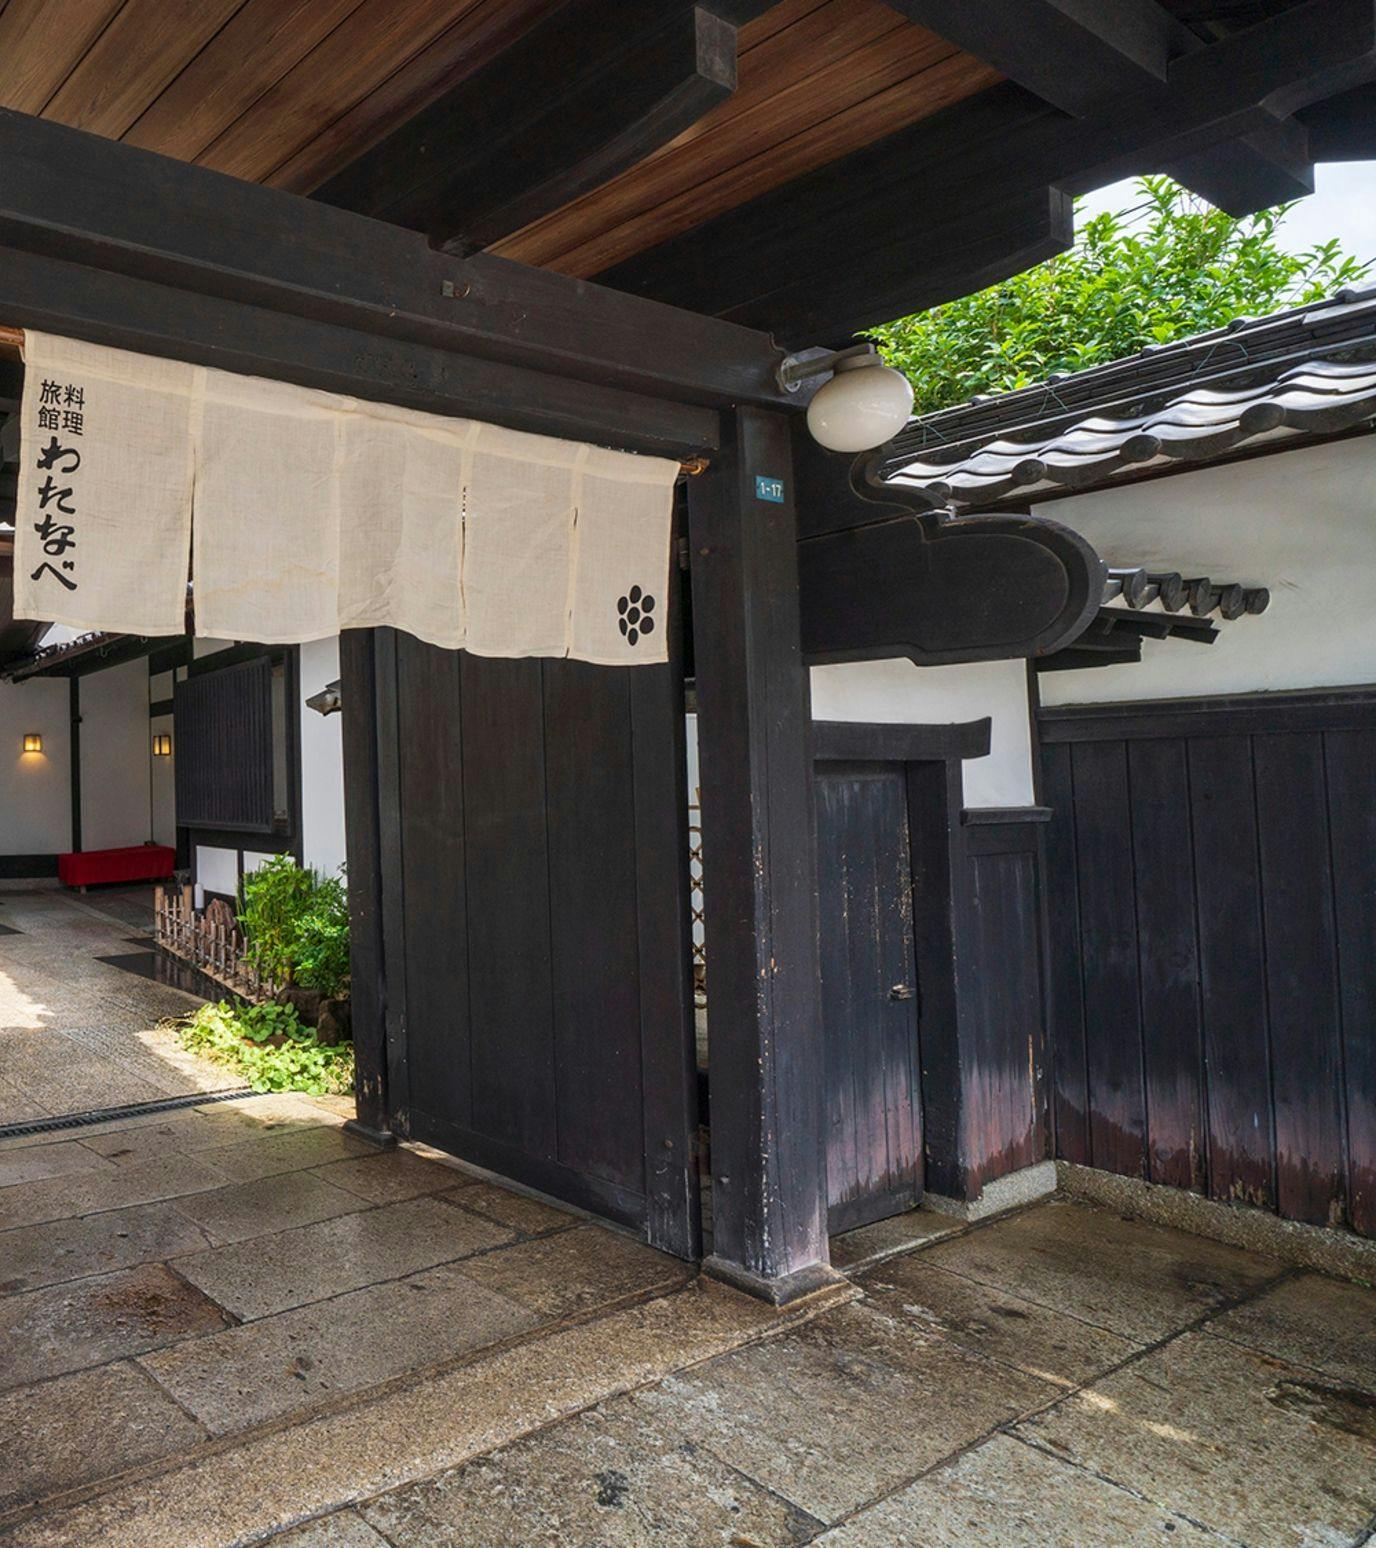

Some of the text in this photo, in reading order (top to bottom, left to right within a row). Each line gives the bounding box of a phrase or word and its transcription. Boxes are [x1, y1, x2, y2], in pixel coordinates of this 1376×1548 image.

[38, 378, 62, 431] 旅館
[61, 383, 86, 437] 料理
[30, 435, 81, 591] わたなべ
[760, 481, 782, 497] 1-17
